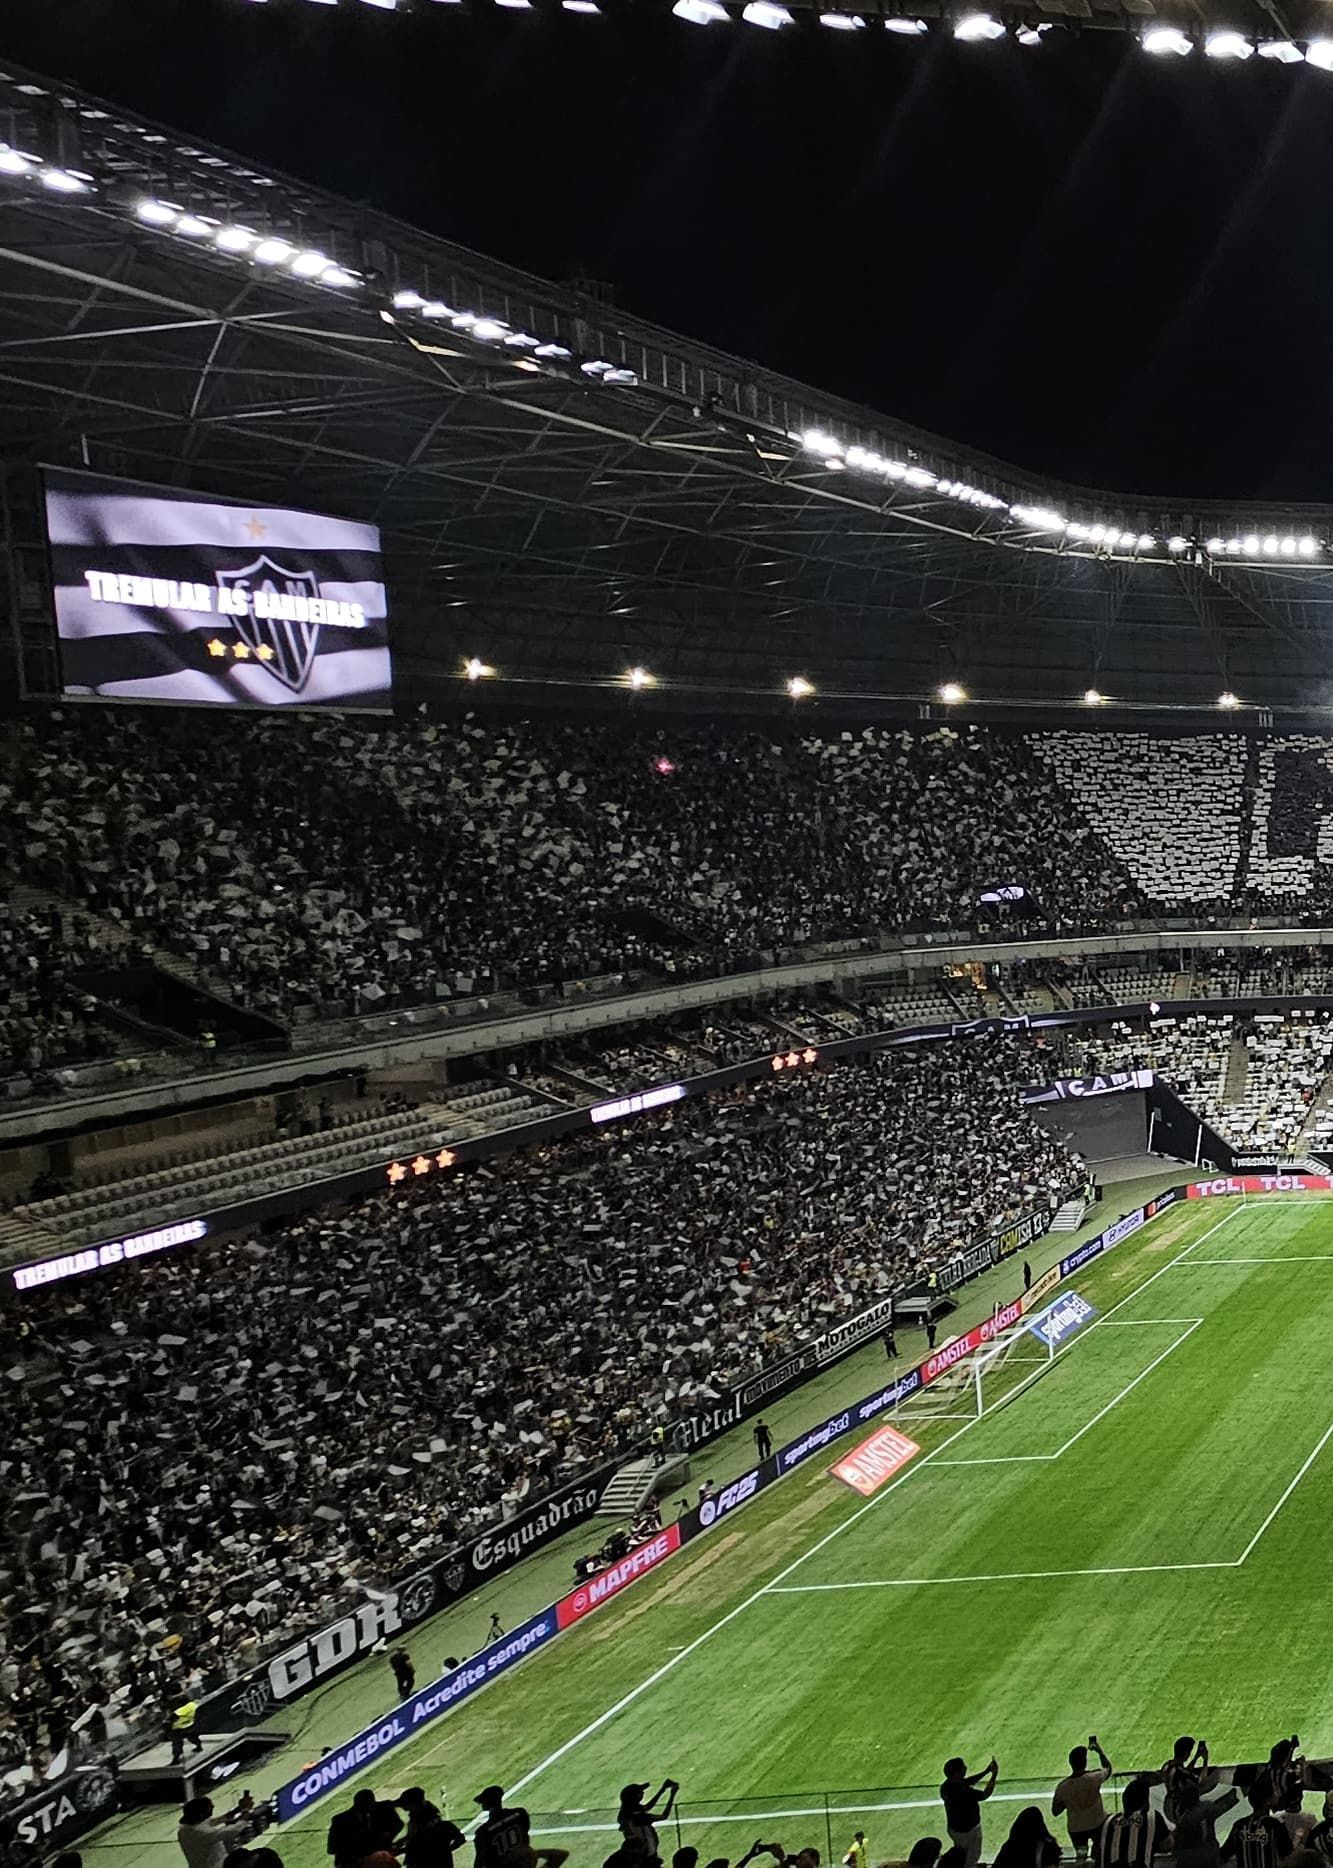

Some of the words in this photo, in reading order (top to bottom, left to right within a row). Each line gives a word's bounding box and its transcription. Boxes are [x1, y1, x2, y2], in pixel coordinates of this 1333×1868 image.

[85, 570, 212, 613] TREMULAR
[218, 597, 248, 616] AS
[254, 595, 364, 629] BANDEIRAS
[1197, 1177, 1242, 1196] TCL
[1261, 1176, 1306, 1190] TCL
[1070, 1239, 1102, 1269] crypto.com
[817, 1301, 890, 1355] MOTOGALO
[989, 1302, 1020, 1334] AMSTEL
[1040, 1294, 1091, 1340] sportingbet
[938, 1336, 972, 1370] AMSTEL
[858, 1372, 918, 1420] sportingbet
[784, 1412, 849, 1465] sportingbet
[853, 1429, 914, 1485] AMSTEL
[716, 1470, 760, 1518] FC25
[472, 1488, 597, 1571] Esquadrão
[588, 1535, 669, 1602] MAPFRE
[268, 1592, 400, 1700] GDR
[291, 1718, 405, 1806] CONMEBOL
[412, 1664, 486, 1724] Acredite
[487, 1624, 546, 1671] sempre
[493, 1828, 519, 1856] 10
